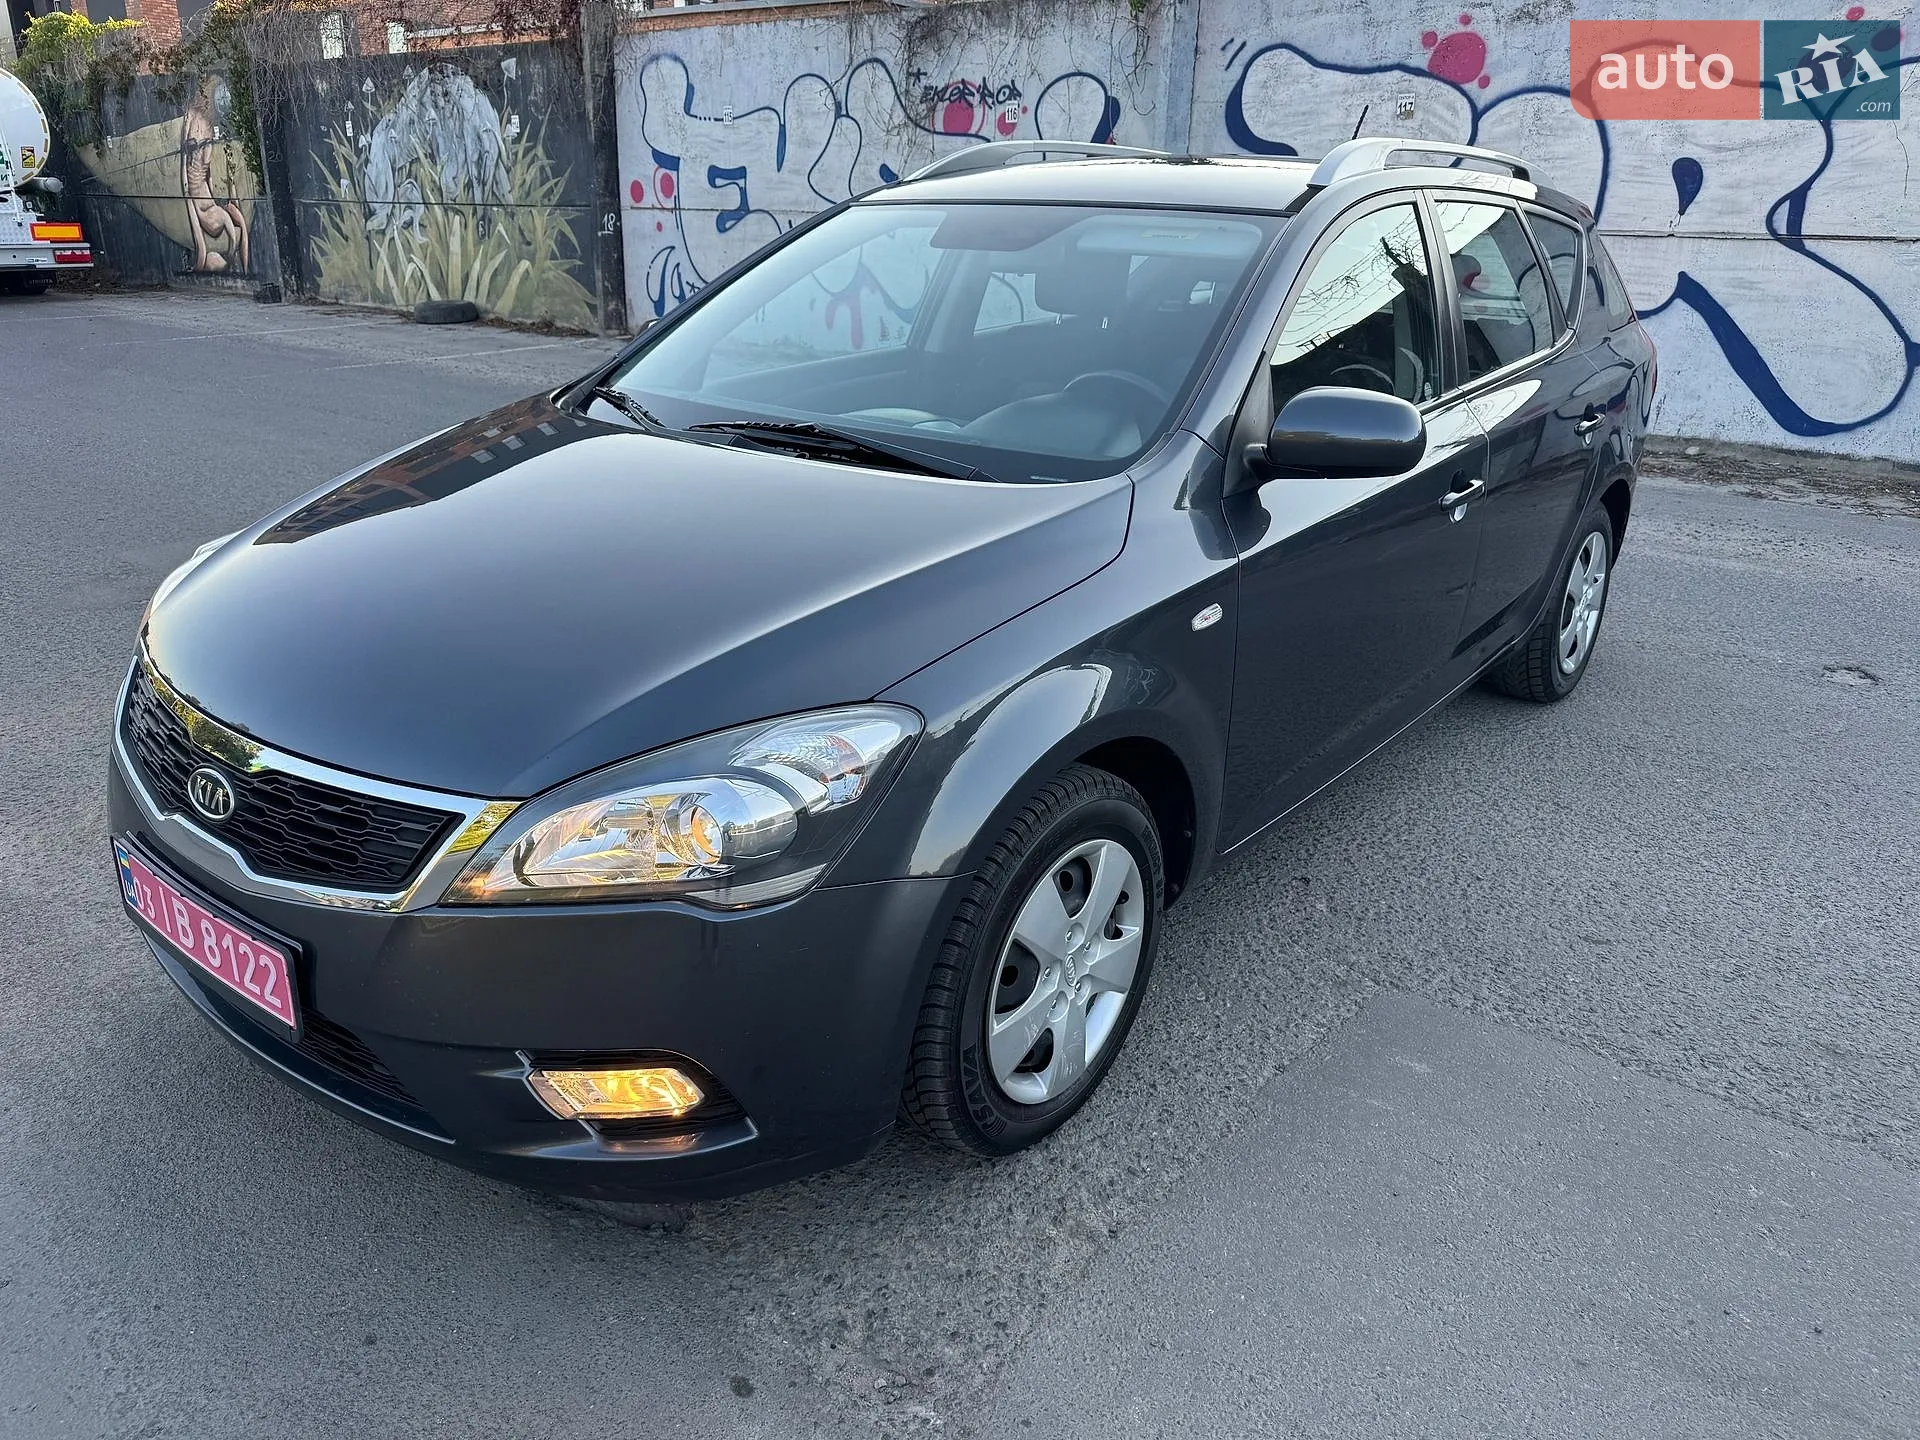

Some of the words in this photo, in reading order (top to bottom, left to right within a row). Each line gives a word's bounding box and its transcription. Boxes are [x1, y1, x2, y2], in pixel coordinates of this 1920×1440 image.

[1006, 107, 1018, 121] 116
[1398, 102, 1413, 114] 117
[602, 213, 616, 233] 18
[194, 775, 229, 814] KIA
[124, 879, 137, 901] UA
[133, 876, 156, 920] 03
[158, 885, 195, 949] IB
[200, 918, 282, 1009] 8122
[960, 1042, 997, 1125] SAVA
